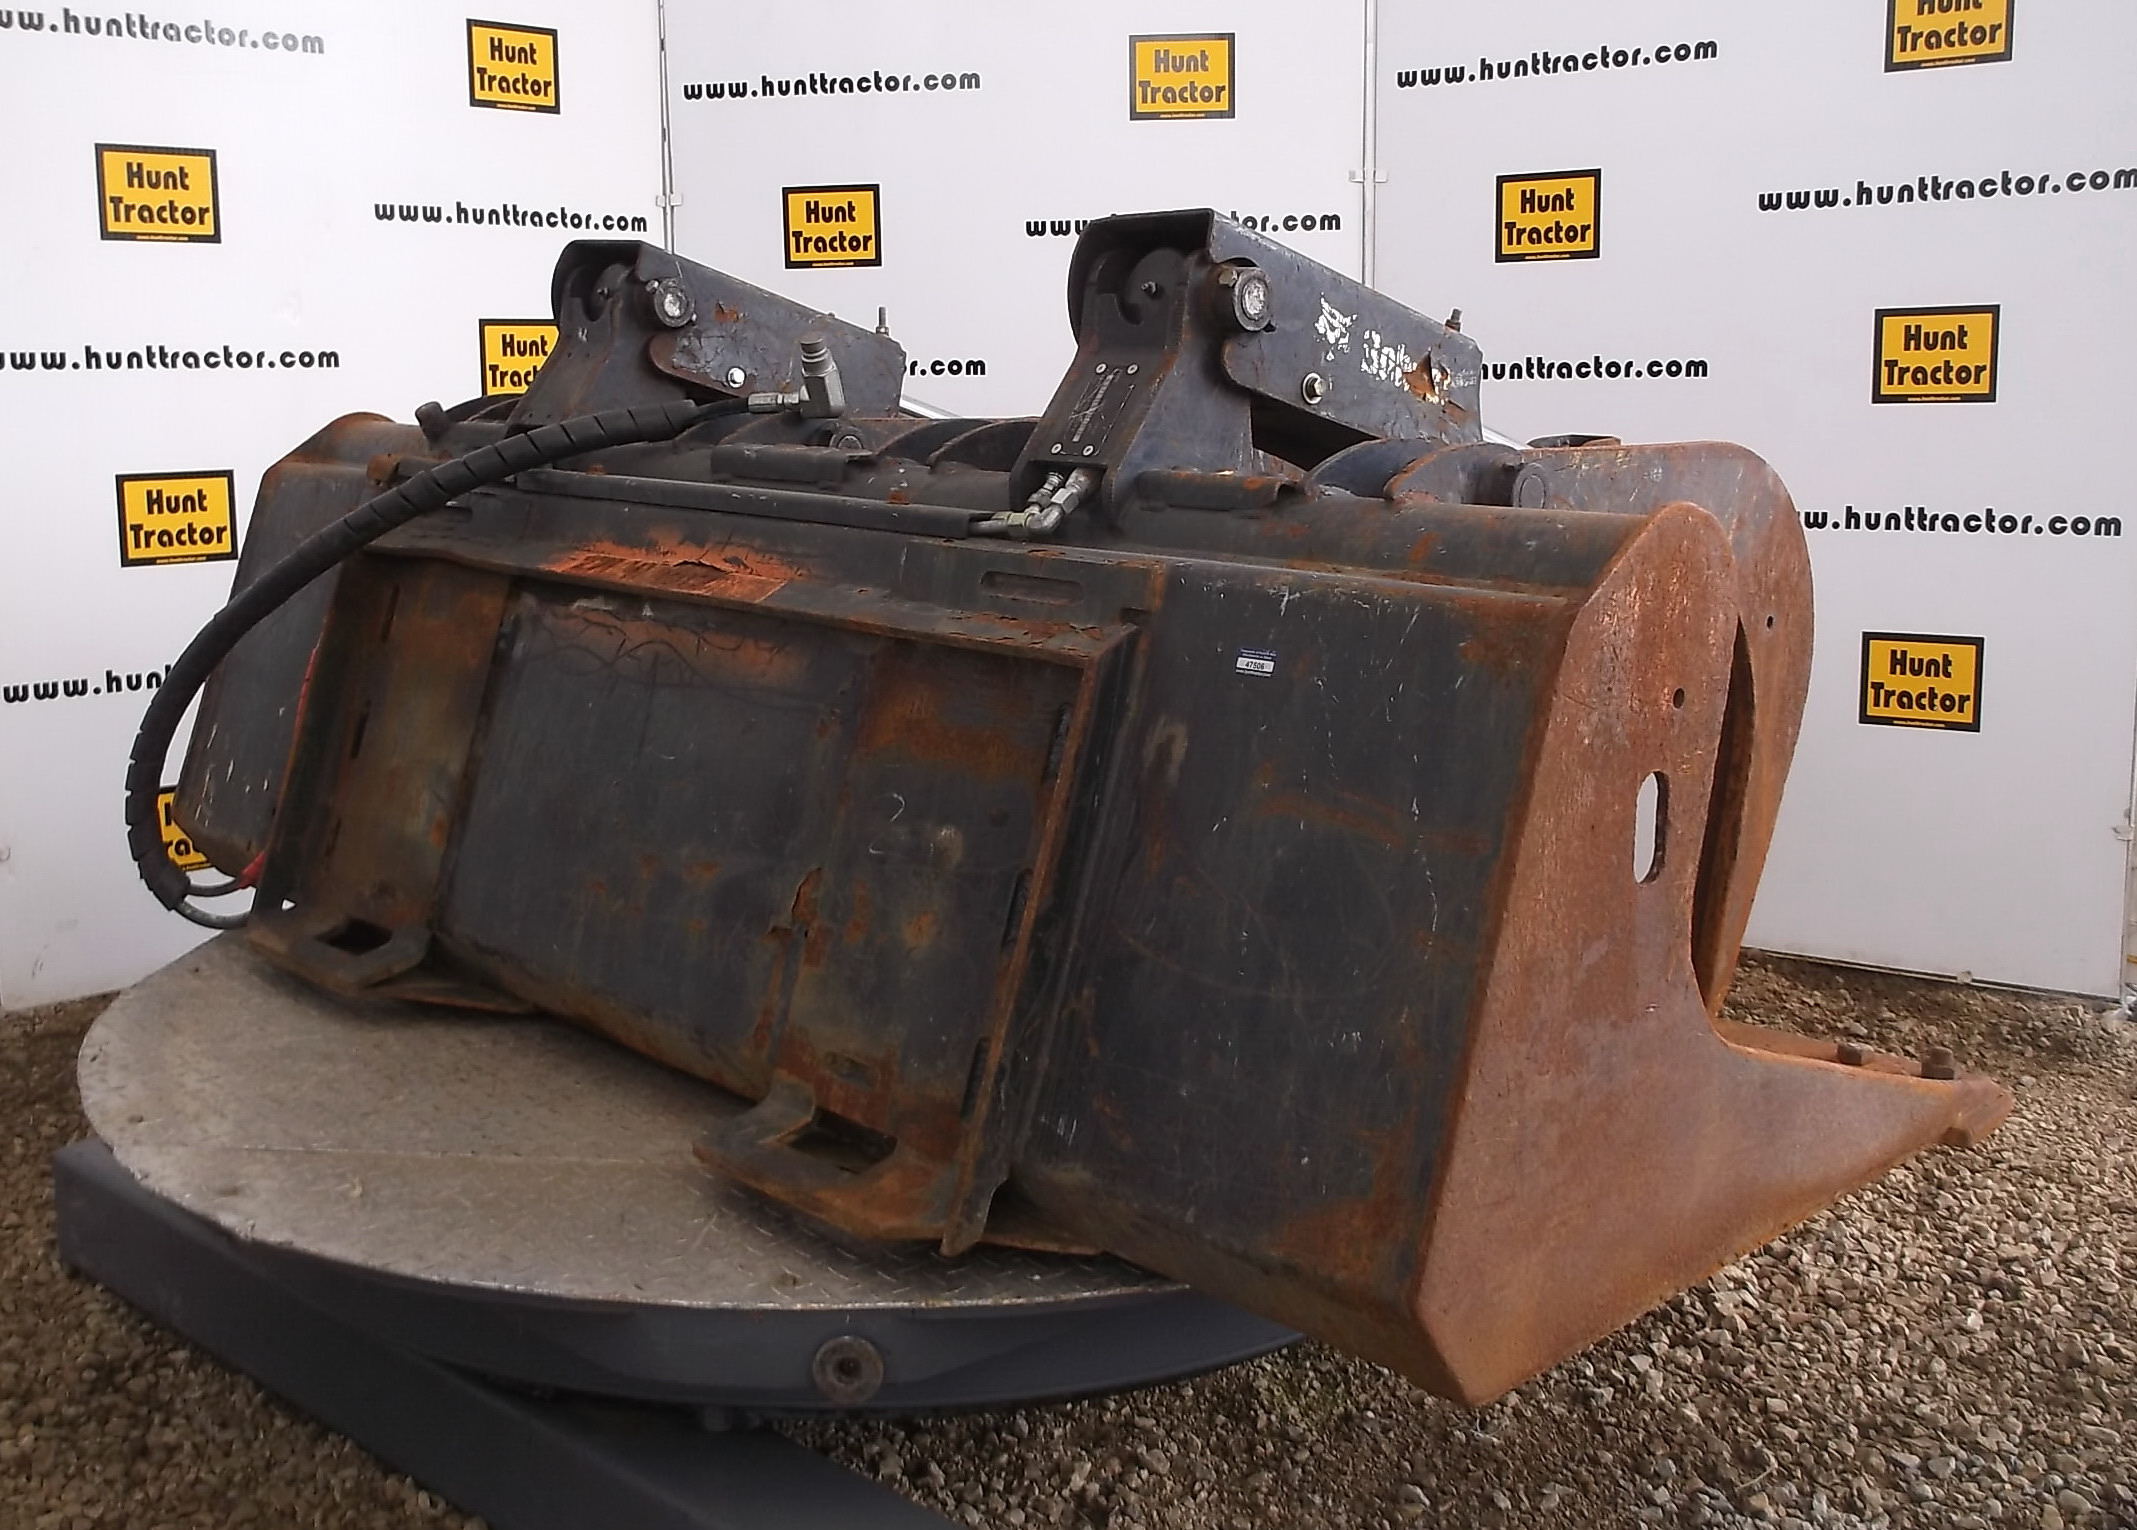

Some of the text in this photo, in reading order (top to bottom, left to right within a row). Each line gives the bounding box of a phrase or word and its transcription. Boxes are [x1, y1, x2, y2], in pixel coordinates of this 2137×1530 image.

[489, 36, 537, 65] Hunt
[1897, 21, 2002, 53] Tractor
[1154, 49, 1208, 74] Hunt
[1398, 41, 1718, 88] www.hunttractor.com
[477, 66, 552, 98] Tractor
[683, 70, 981, 100] www.hunttractor.com
[1139, 78, 1226, 104] Tractor
[126, 161, 190, 191] Hunt
[1759, 168, 2137, 212] www.hunttractor.com
[109, 195, 210, 226] Tractor
[805, 200, 856, 224] Hunt
[1520, 187, 1575, 214] Hunt
[374, 201, 648, 233] www.hunttractor.com
[792, 228, 873, 254] Tractor
[1504, 219, 1591, 247] Tractor
[502, 334, 548, 357] Hunt
[1904, 324, 1968, 352] Hunt
[0, 345, 340, 370] ww.hunttractor.com
[1882, 360, 1987, 386] Tractor
[146, 488, 208, 515] Hunt
[1798, 506, 2122, 536] w.hunttractor.com
[130, 523, 227, 550] Tractor
[1889, 649, 1952, 678] Hunt
[1871, 682, 1970, 713] Tractor
